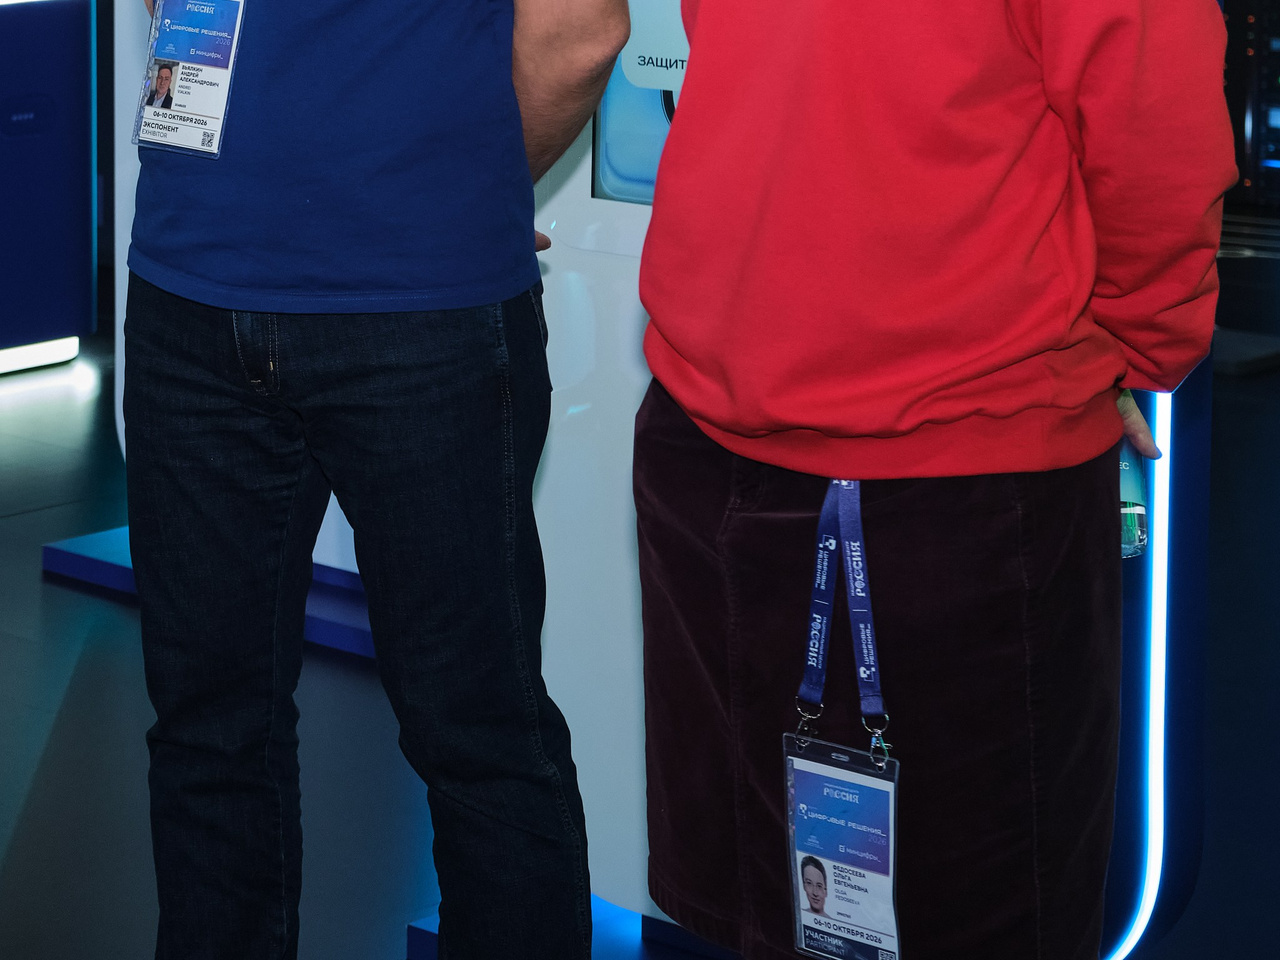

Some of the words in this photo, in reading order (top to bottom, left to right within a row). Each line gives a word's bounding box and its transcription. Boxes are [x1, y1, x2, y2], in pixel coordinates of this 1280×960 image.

[186, 4, 215, 14] РОССИЯ
[170, 24, 200, 34] ЦИФРОВЫЕ
[216, 37, 230, 46] 2026
[180, 70, 199, 78] АНДРЕЙ
[152, 110, 168, 120] 06-10
[168, 112, 194, 125] ОКТЯБРЯ
[194, 116, 208, 126] 2026
[142, 120, 179, 133] ЭКСПОНЕНТ
[142, 128, 168, 138] EXHIBITOR
[821, 550, 829, 590] ЦИФРОВЫЕ
[850, 541, 866, 598] РОССИЯ
[808, 614, 822, 668] РОССИЯ
[859, 624, 870, 665] ЦИФРОВЫЕ
[824, 788, 860, 804] РОССИЯ
[832, 864, 866, 879] ФЕДОСЕЕВА
[834, 871, 852, 882] ОЛЬГА
[834, 878, 869, 894] ЕВГЕНЬЕВНА
[804, 928, 844, 948] УЧАСТНИК
[814, 918, 832, 930] 06-10
[832, 922, 864, 938] ОКТЯБРЯ
[865, 932, 883, 944] 2026
